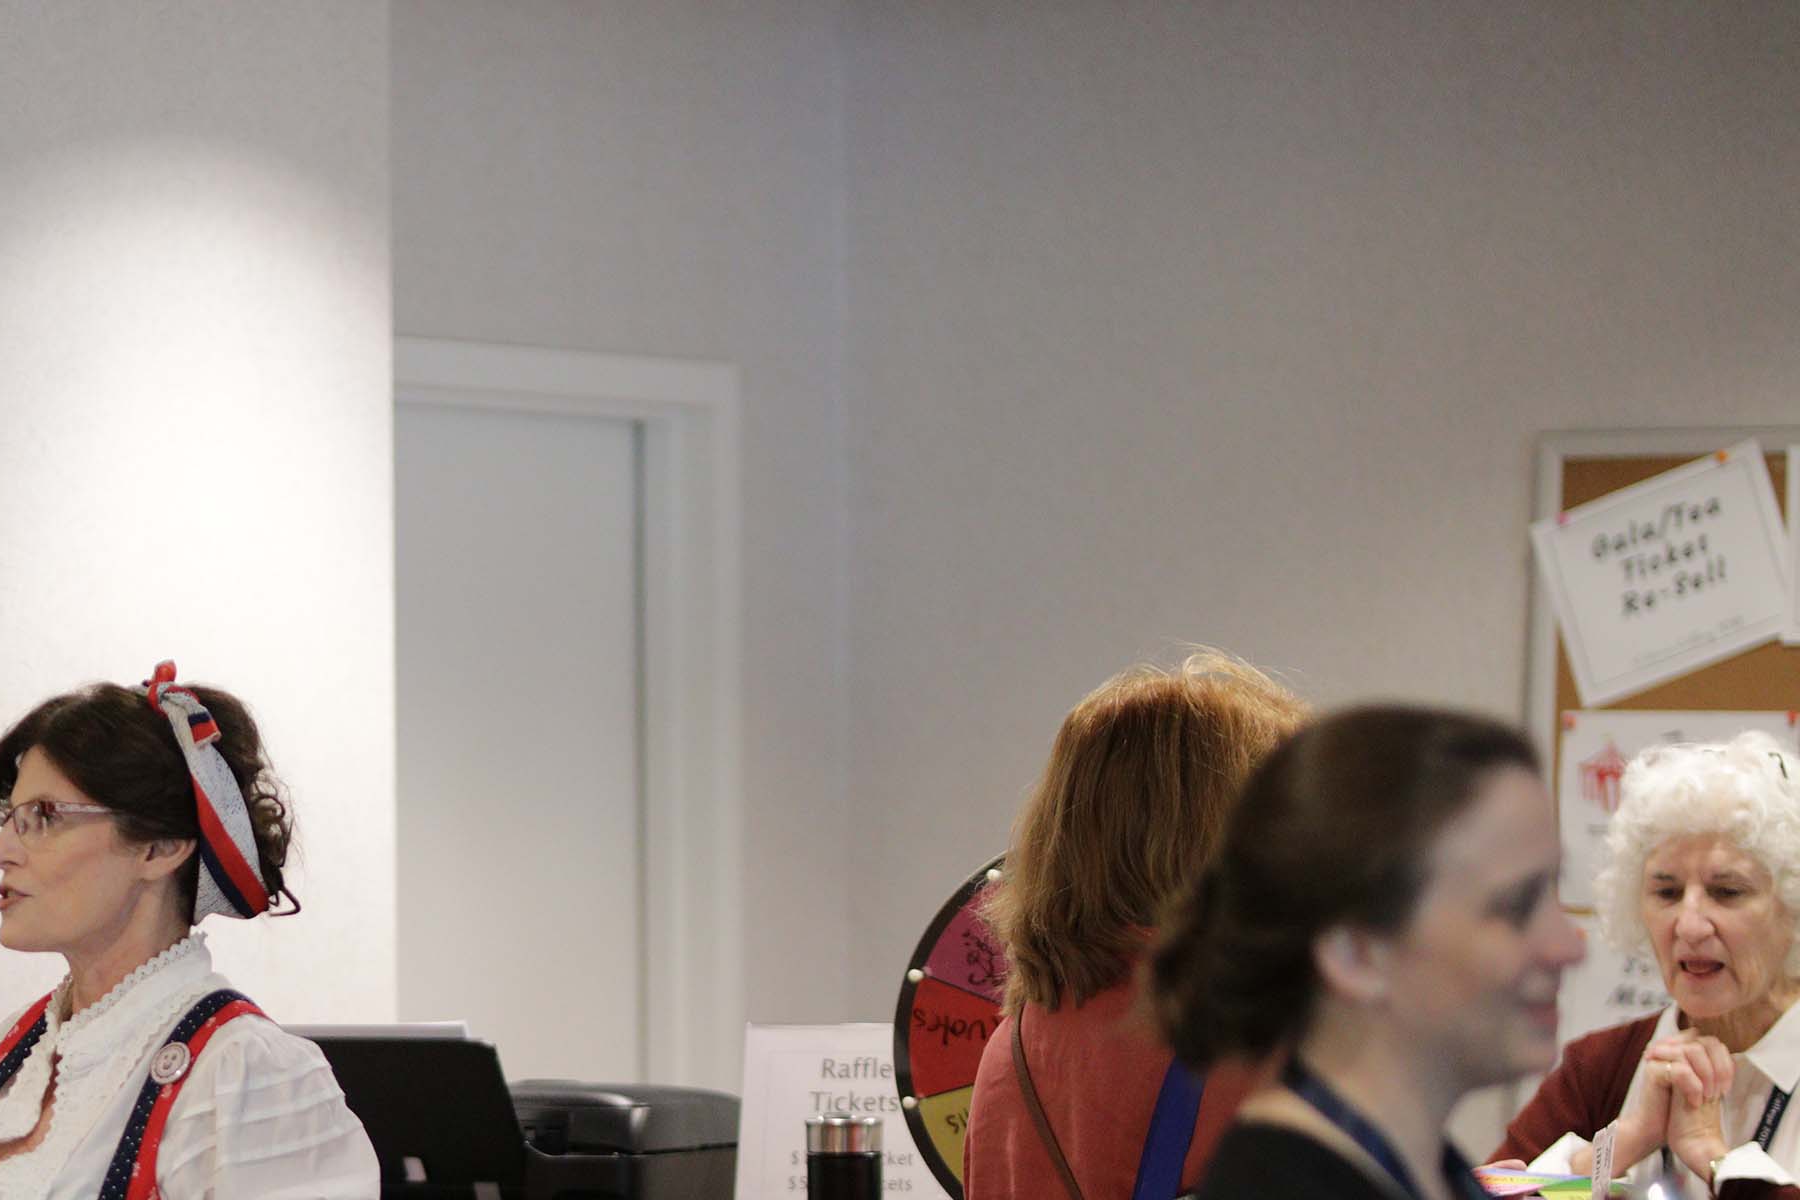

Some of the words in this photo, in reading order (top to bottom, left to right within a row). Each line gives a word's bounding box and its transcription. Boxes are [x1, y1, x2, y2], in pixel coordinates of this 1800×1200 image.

[1621, 533, 1708, 582] Ticket
[821, 1057, 892, 1080] Raffle
[810, 1091, 899, 1113] Tickets
